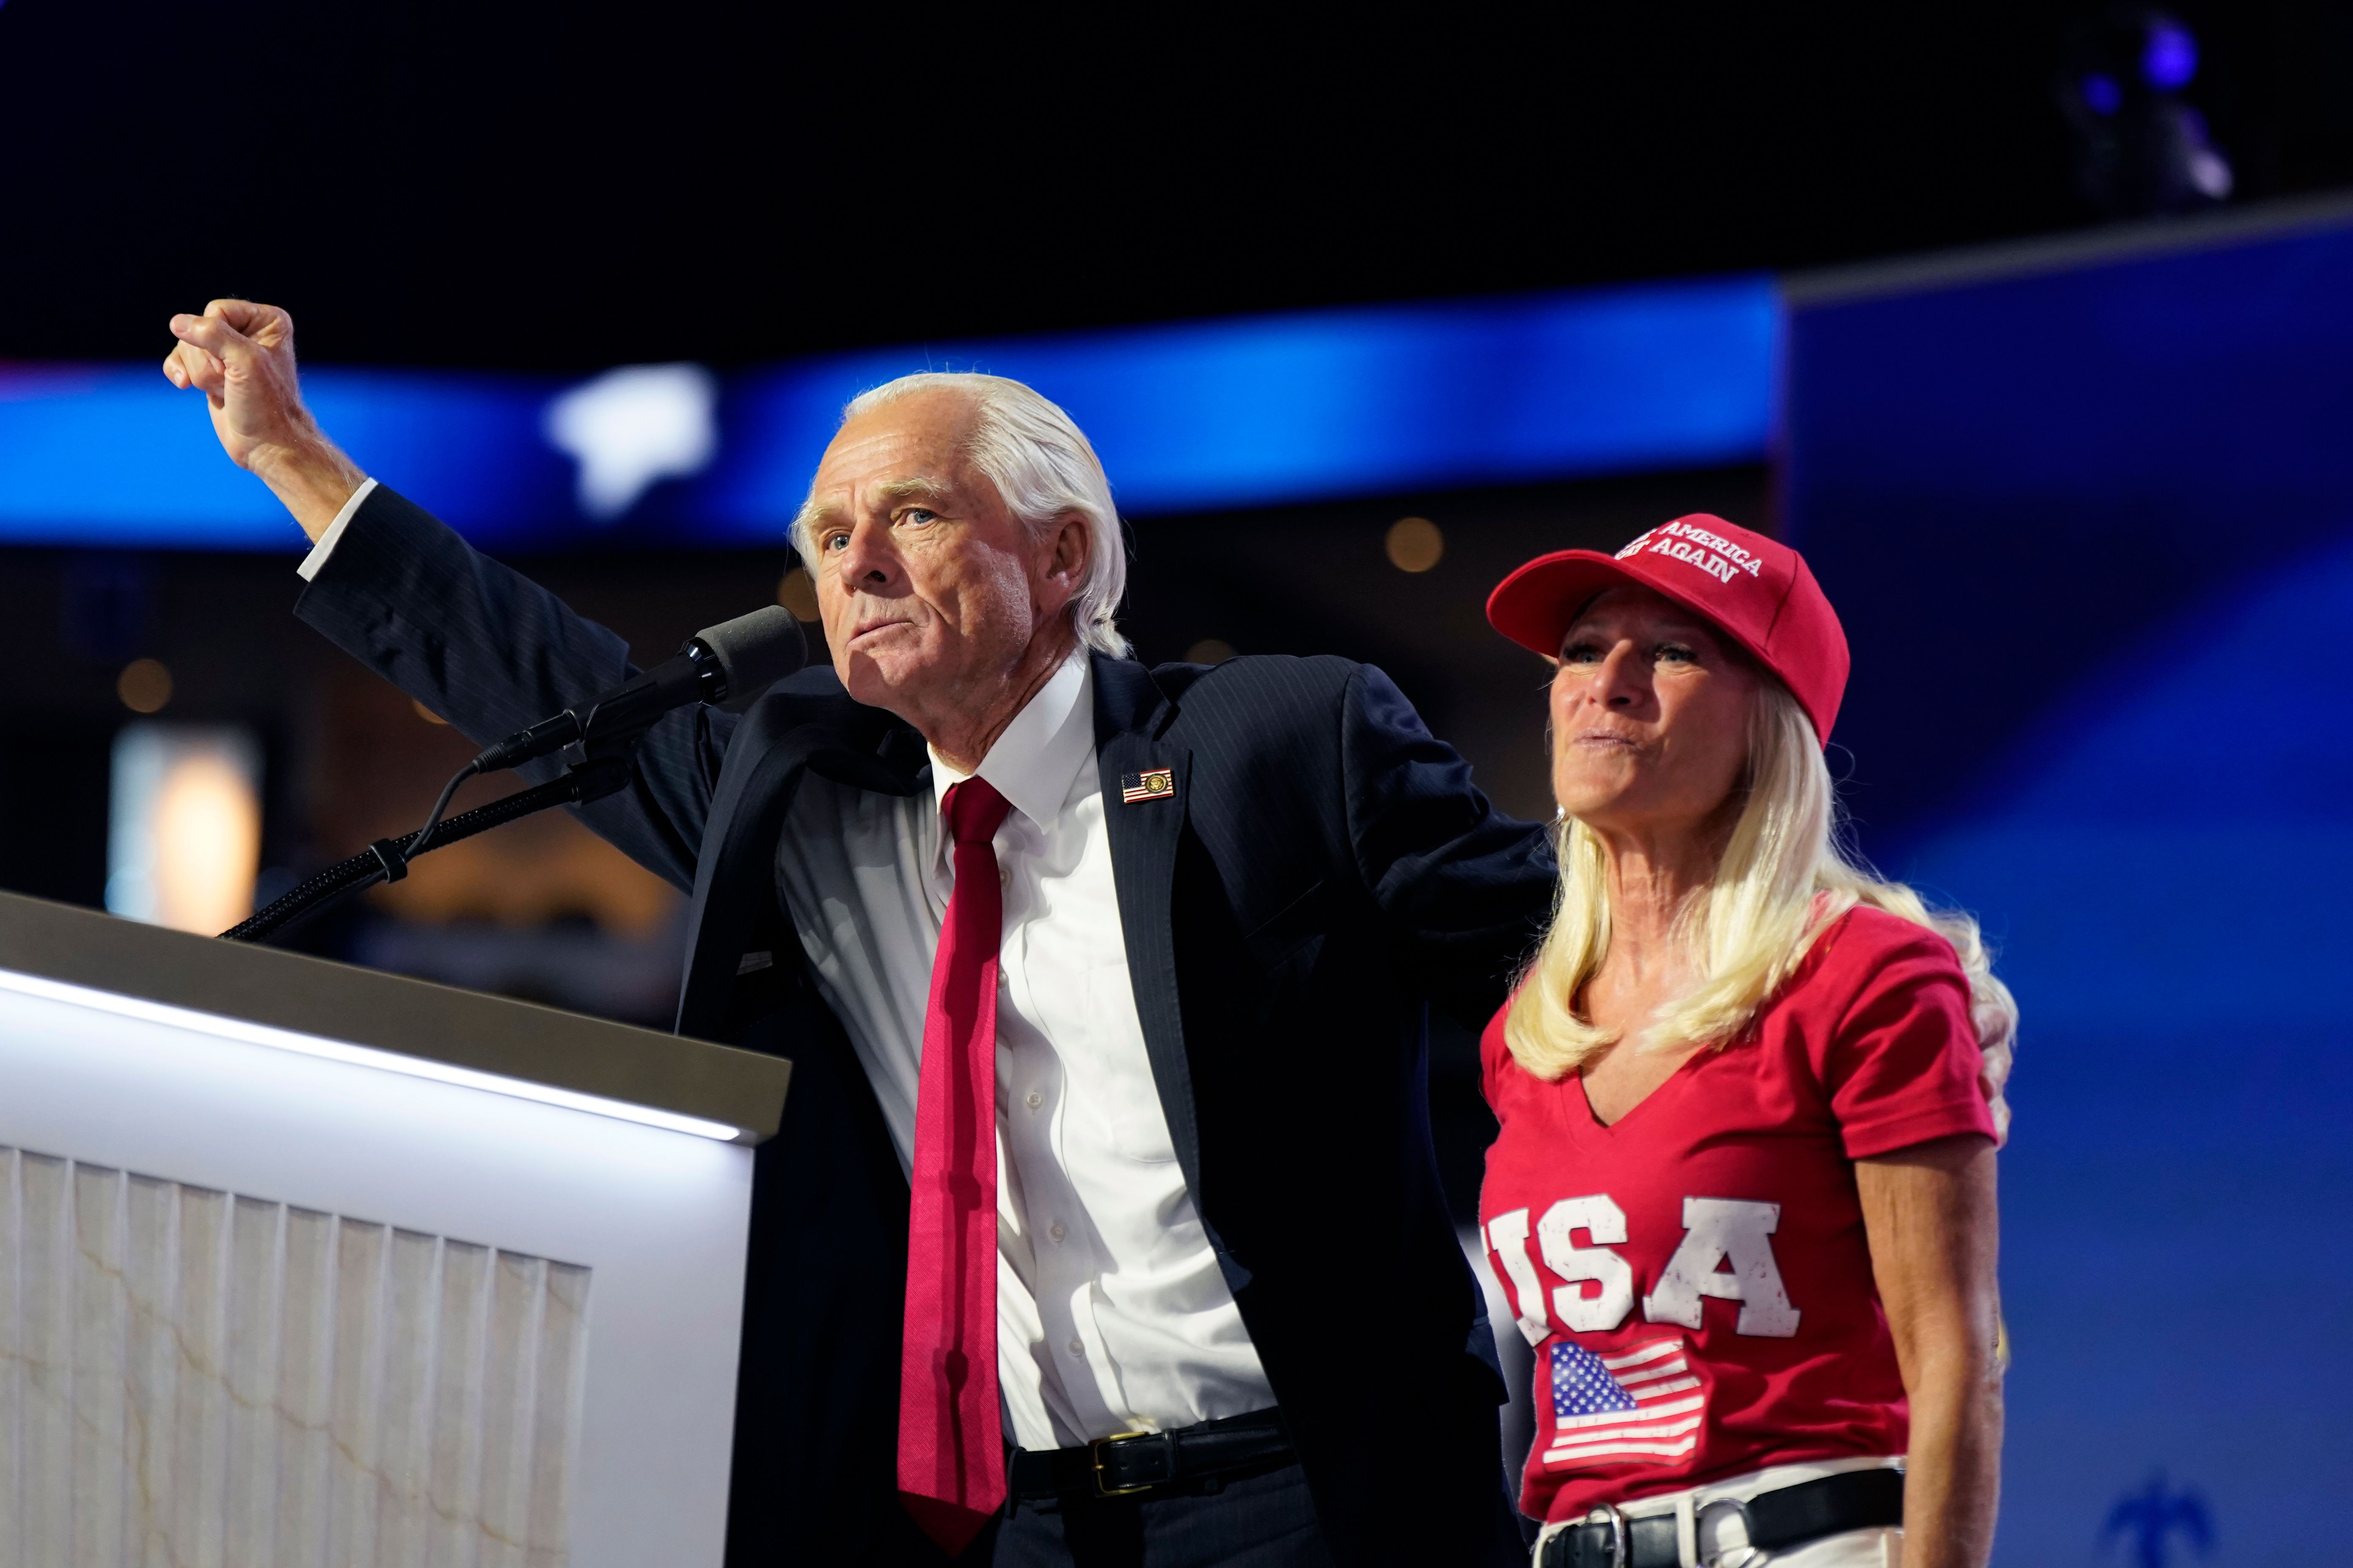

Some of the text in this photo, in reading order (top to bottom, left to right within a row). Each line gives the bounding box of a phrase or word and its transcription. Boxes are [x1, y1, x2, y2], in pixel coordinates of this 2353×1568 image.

[1649, 538, 1740, 584] AGAIN
[1658, 522, 1762, 577] AMERICA
[1481, 1194, 1802, 1347] USA
